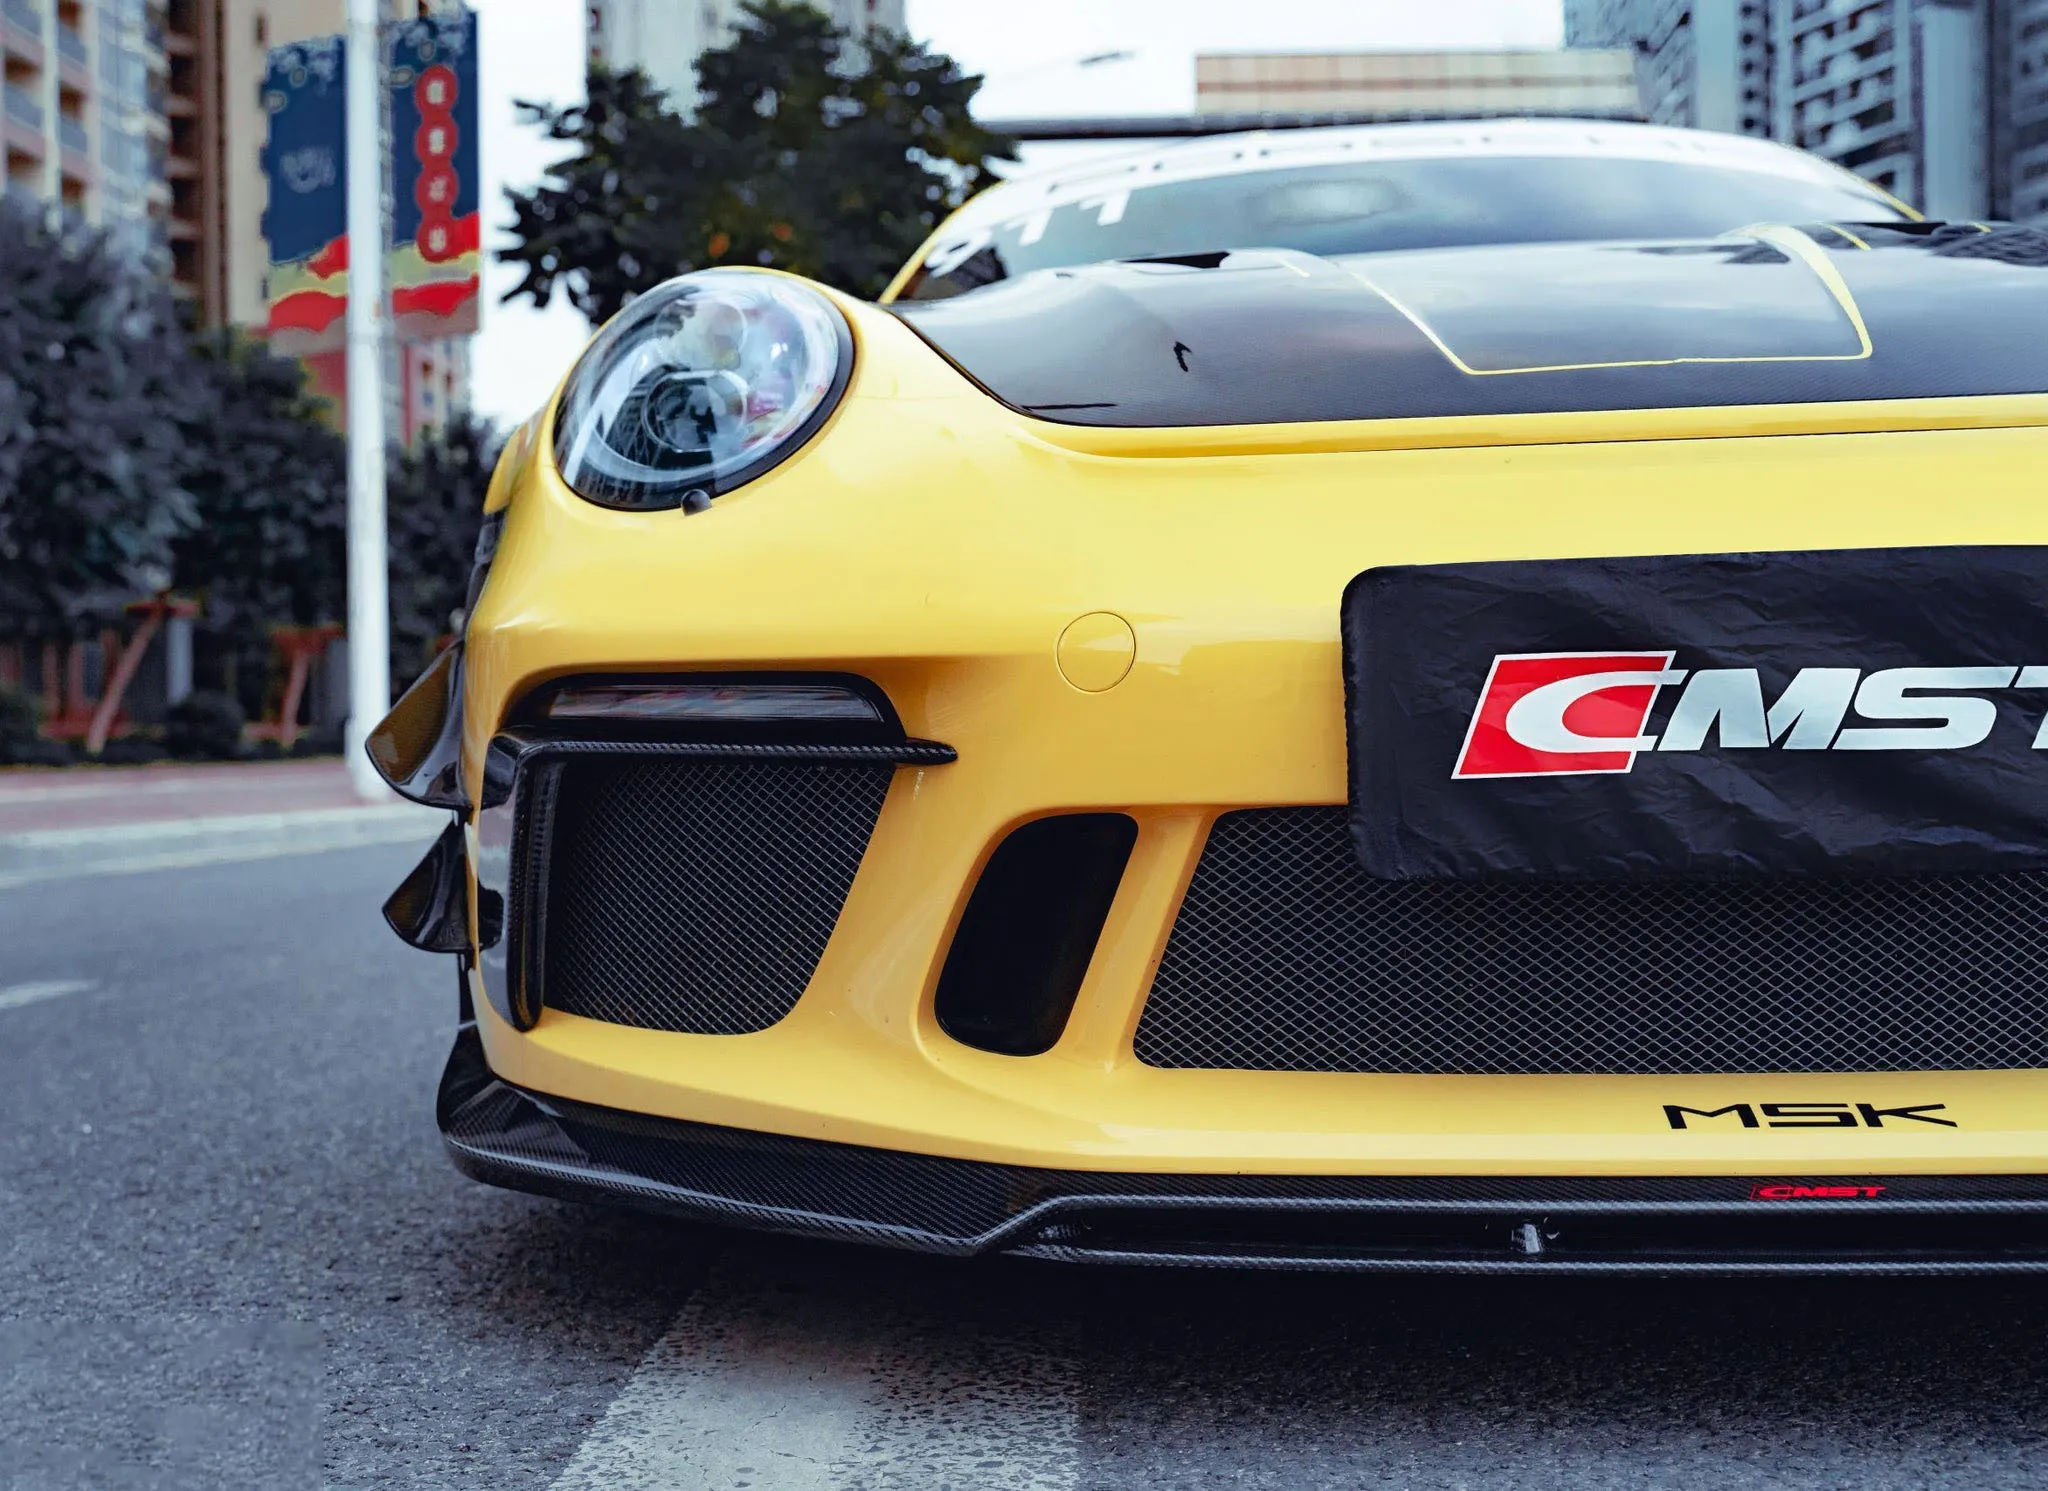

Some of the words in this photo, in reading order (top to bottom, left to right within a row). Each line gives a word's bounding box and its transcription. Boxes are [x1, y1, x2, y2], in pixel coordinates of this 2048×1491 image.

[1505, 666, 2048, 751] CMS
[1662, 1103, 1959, 1130] MSK
[1757, 1184, 1887, 1199] CMST
